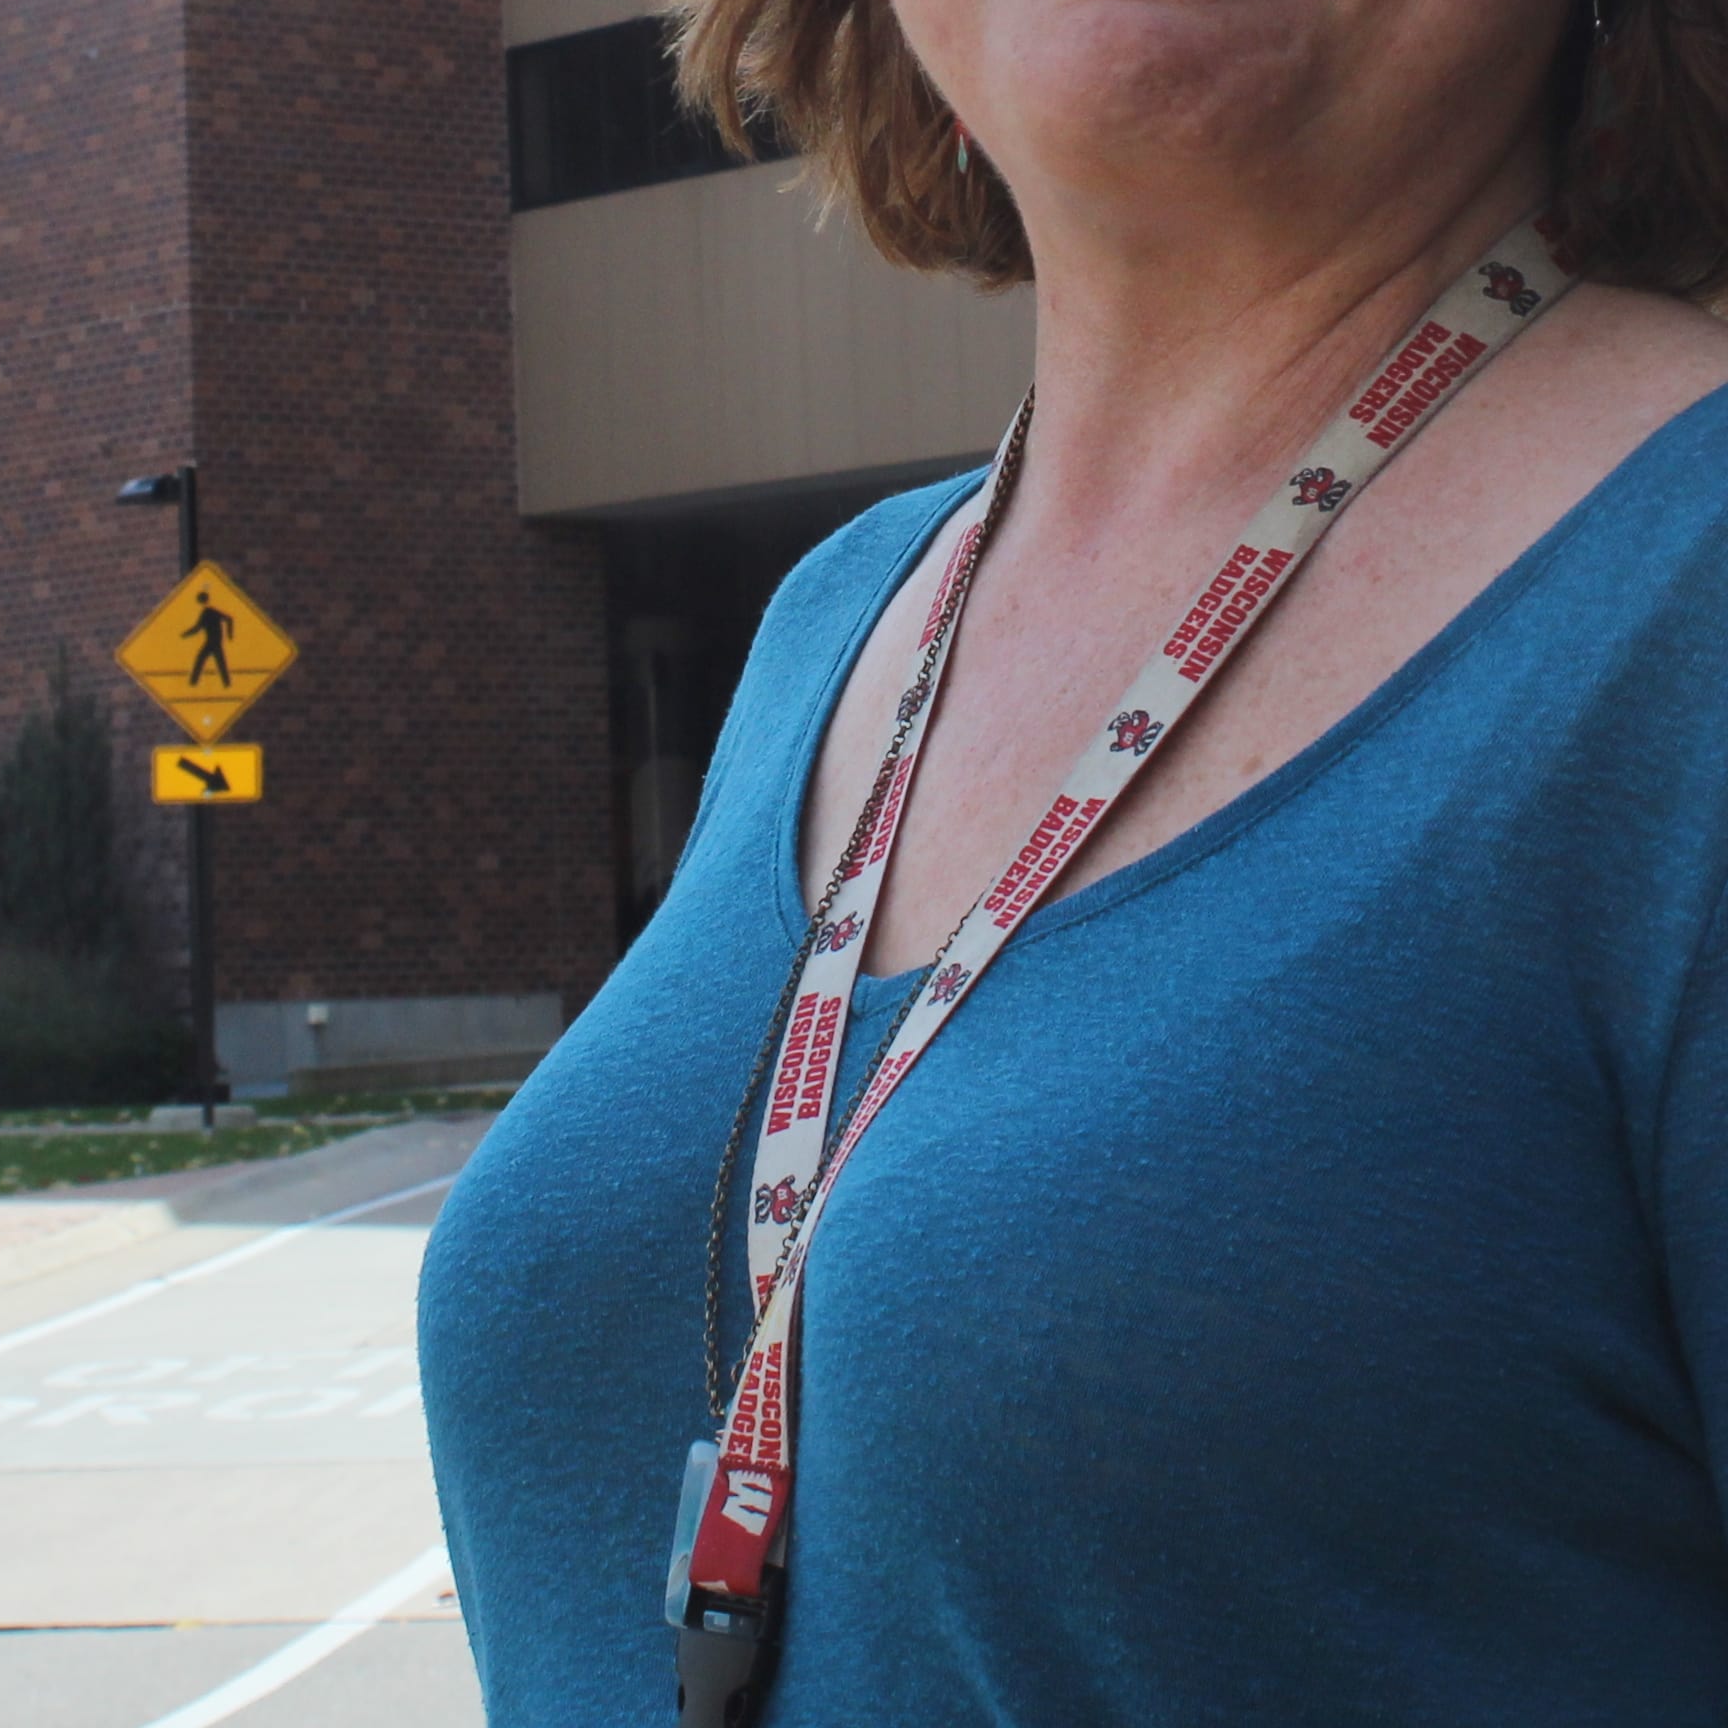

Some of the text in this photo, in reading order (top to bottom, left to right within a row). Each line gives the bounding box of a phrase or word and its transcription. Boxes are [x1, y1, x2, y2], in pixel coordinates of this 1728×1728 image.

[1348, 320, 1453, 426] BADGERS
[1365, 332, 1488, 449] WISCONSIN
[1162, 543, 1261, 661] BADGERS
[1177, 547, 1295, 683] WISCONSIN
[983, 793, 1080, 913] BADGERS
[992, 797, 1108, 931] WISCONSIN
[766, 991, 820, 1137] WISCONSIN
[797, 995, 842, 1121] BADGERS
